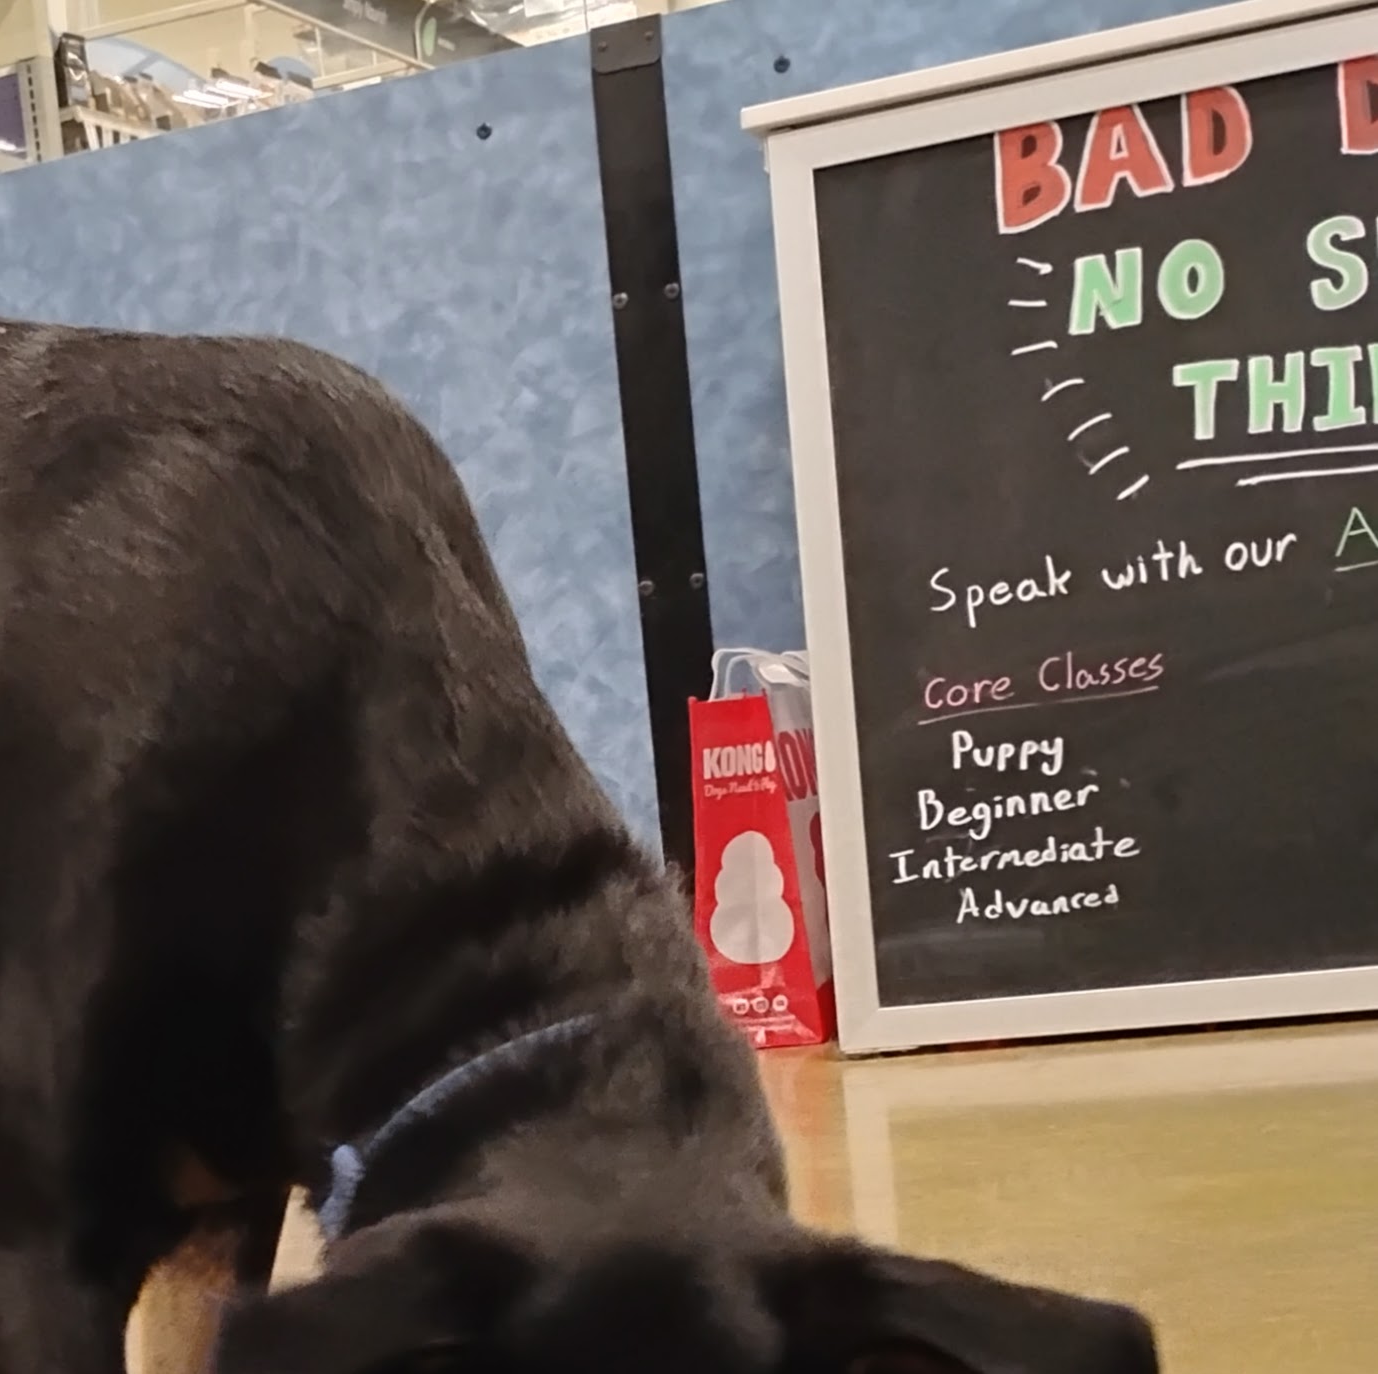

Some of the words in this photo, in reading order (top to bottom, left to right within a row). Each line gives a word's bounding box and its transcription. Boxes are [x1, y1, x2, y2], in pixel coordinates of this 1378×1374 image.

[994, 85, 1253, 234] BAD
[1068, 238, 1225, 335] NO
[1306, 214, 1378, 311] S
[929, 555, 1074, 629] Speak
[1101, 540, 1203, 592] with
[1225, 532, 1298, 573] our
[924, 673, 1014, 709] Core
[1038, 650, 1165, 690] Classes
[702, 742, 764, 780] KONG
[952, 730, 1064, 776] Puppy
[917, 782, 1101, 839] Beginner
[891, 828, 1140, 884] Intermediate
[957, 884, 1120, 923] Advanced
